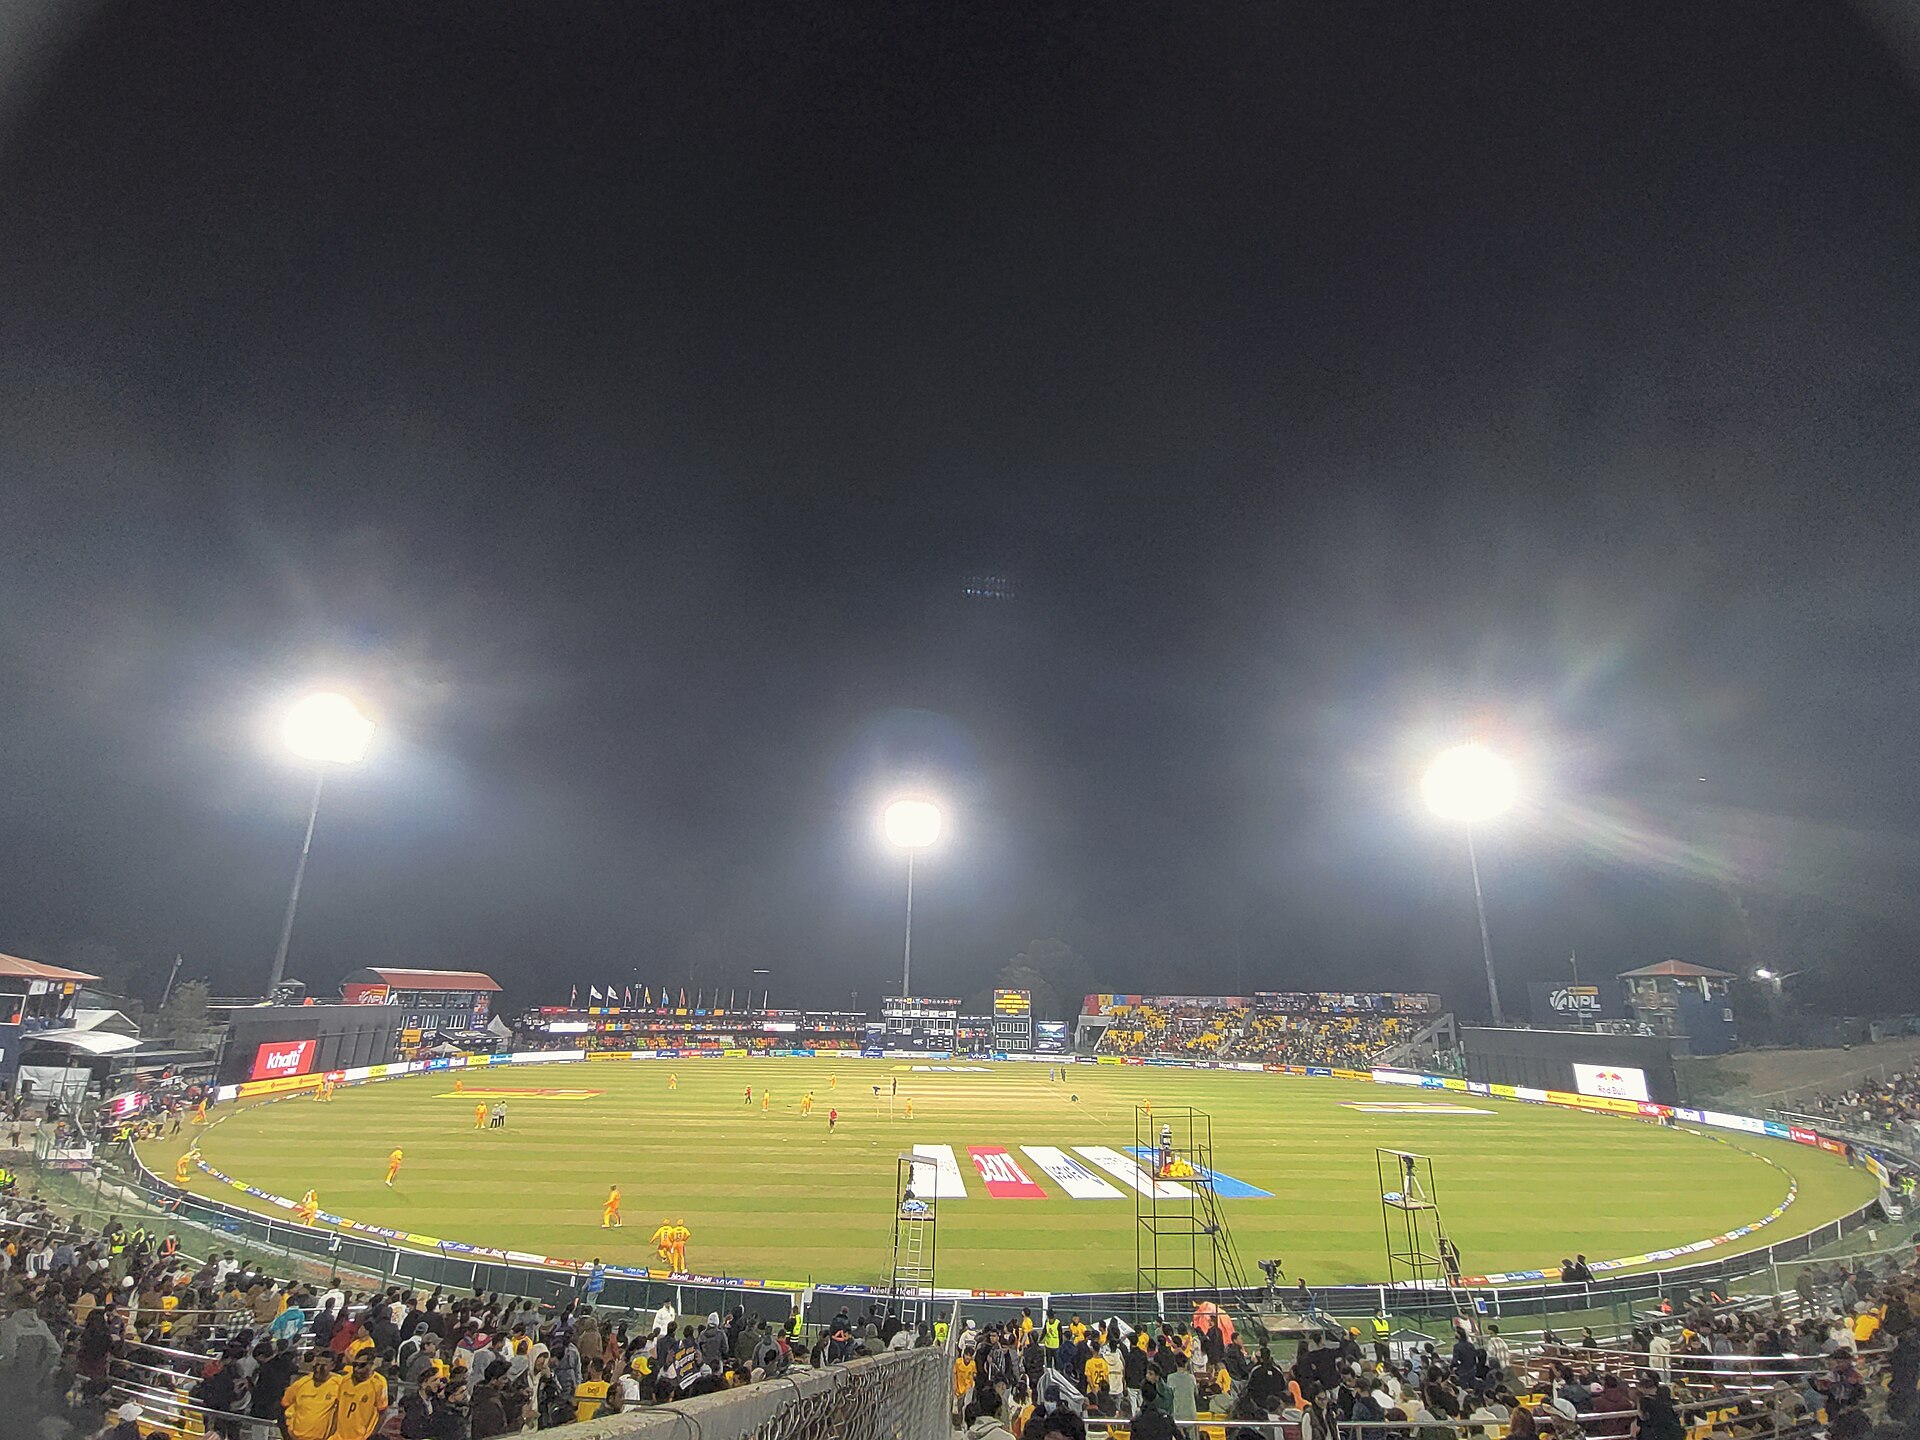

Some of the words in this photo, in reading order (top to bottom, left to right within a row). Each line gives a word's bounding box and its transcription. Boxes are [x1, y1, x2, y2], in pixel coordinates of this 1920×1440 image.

[1568, 996, 1601, 1008] NPL
[1598, 1085, 1611, 1094] Red
[1612, 1086, 1626, 1096] Bull
[973, 1153, 1016, 1182] KFC
[671, 1272, 689, 1281] Ncell
[693, 1275, 713, 1283] Ncell
